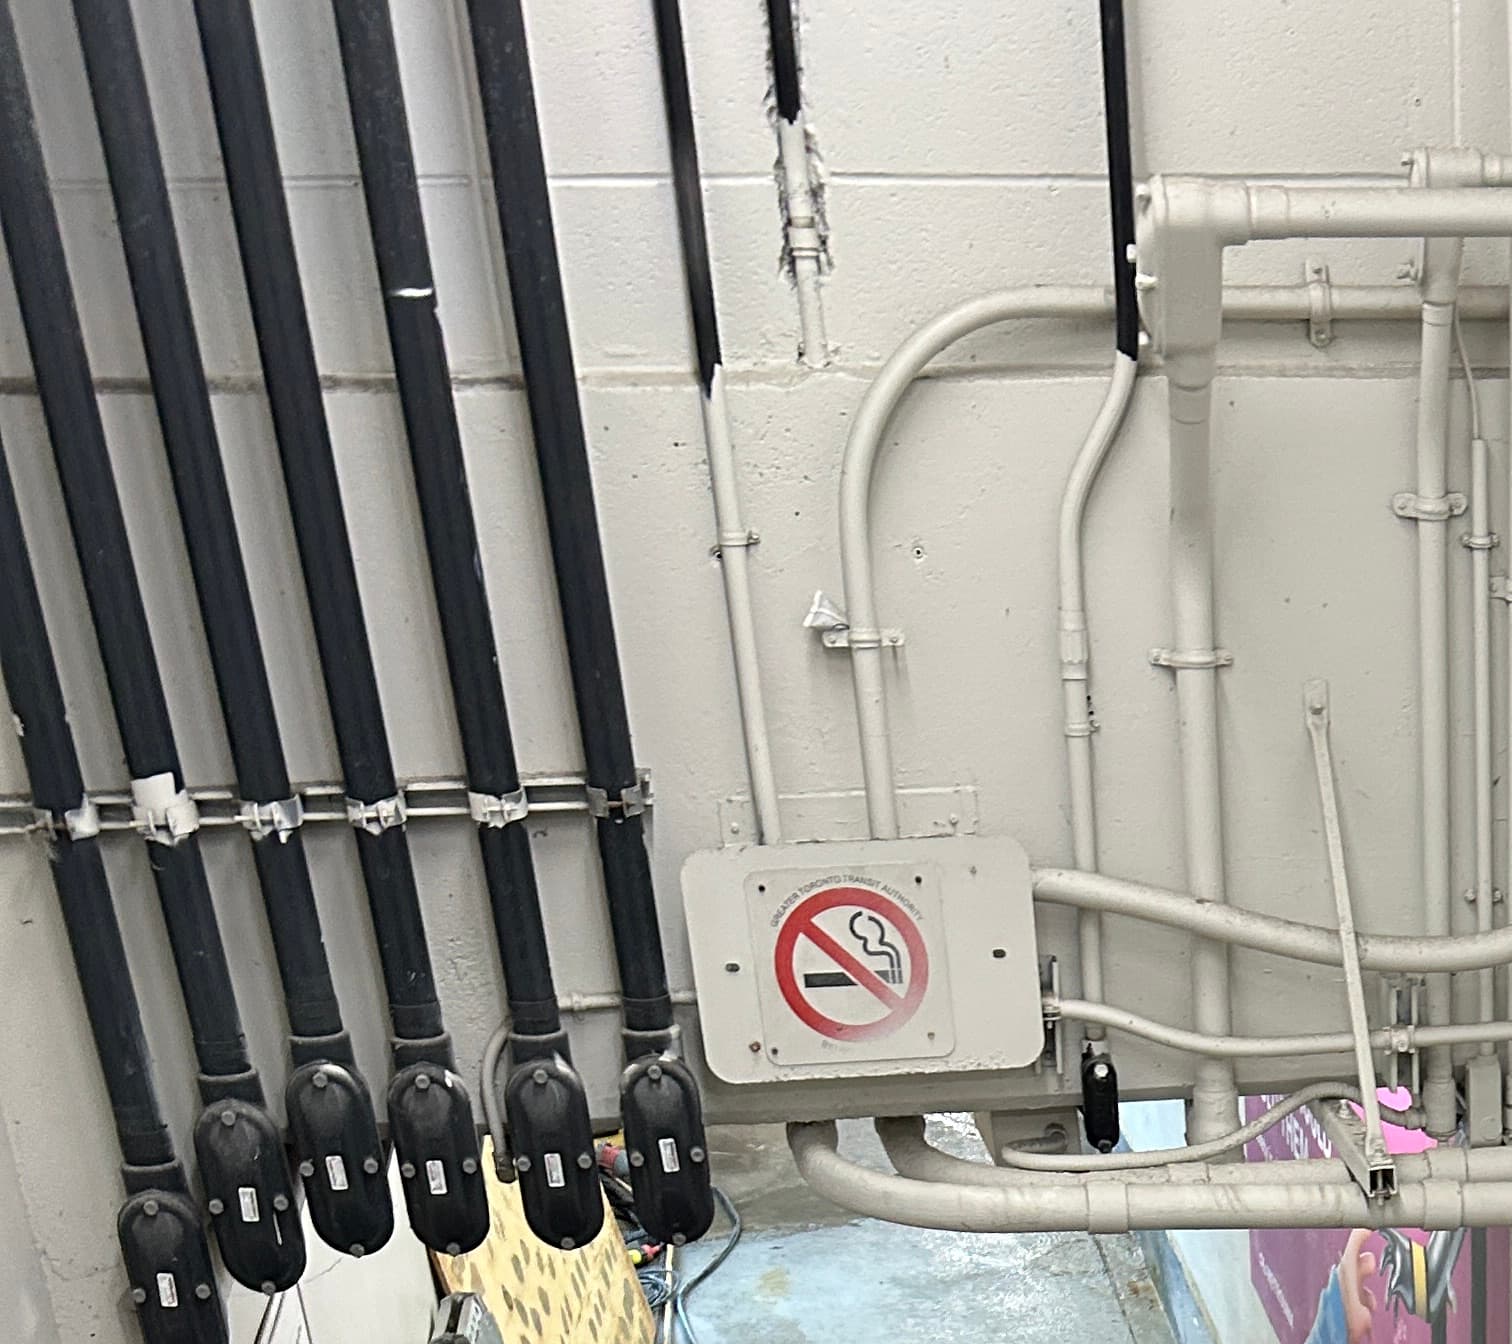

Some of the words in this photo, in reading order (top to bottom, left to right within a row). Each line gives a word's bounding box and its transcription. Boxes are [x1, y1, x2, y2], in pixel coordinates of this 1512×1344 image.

[770, 892, 800, 927] GREATER
[798, 875, 842, 893] TORONTO
[843, 874, 882, 888] TRANSIT
[881, 884, 924, 921] AUTHORITY
